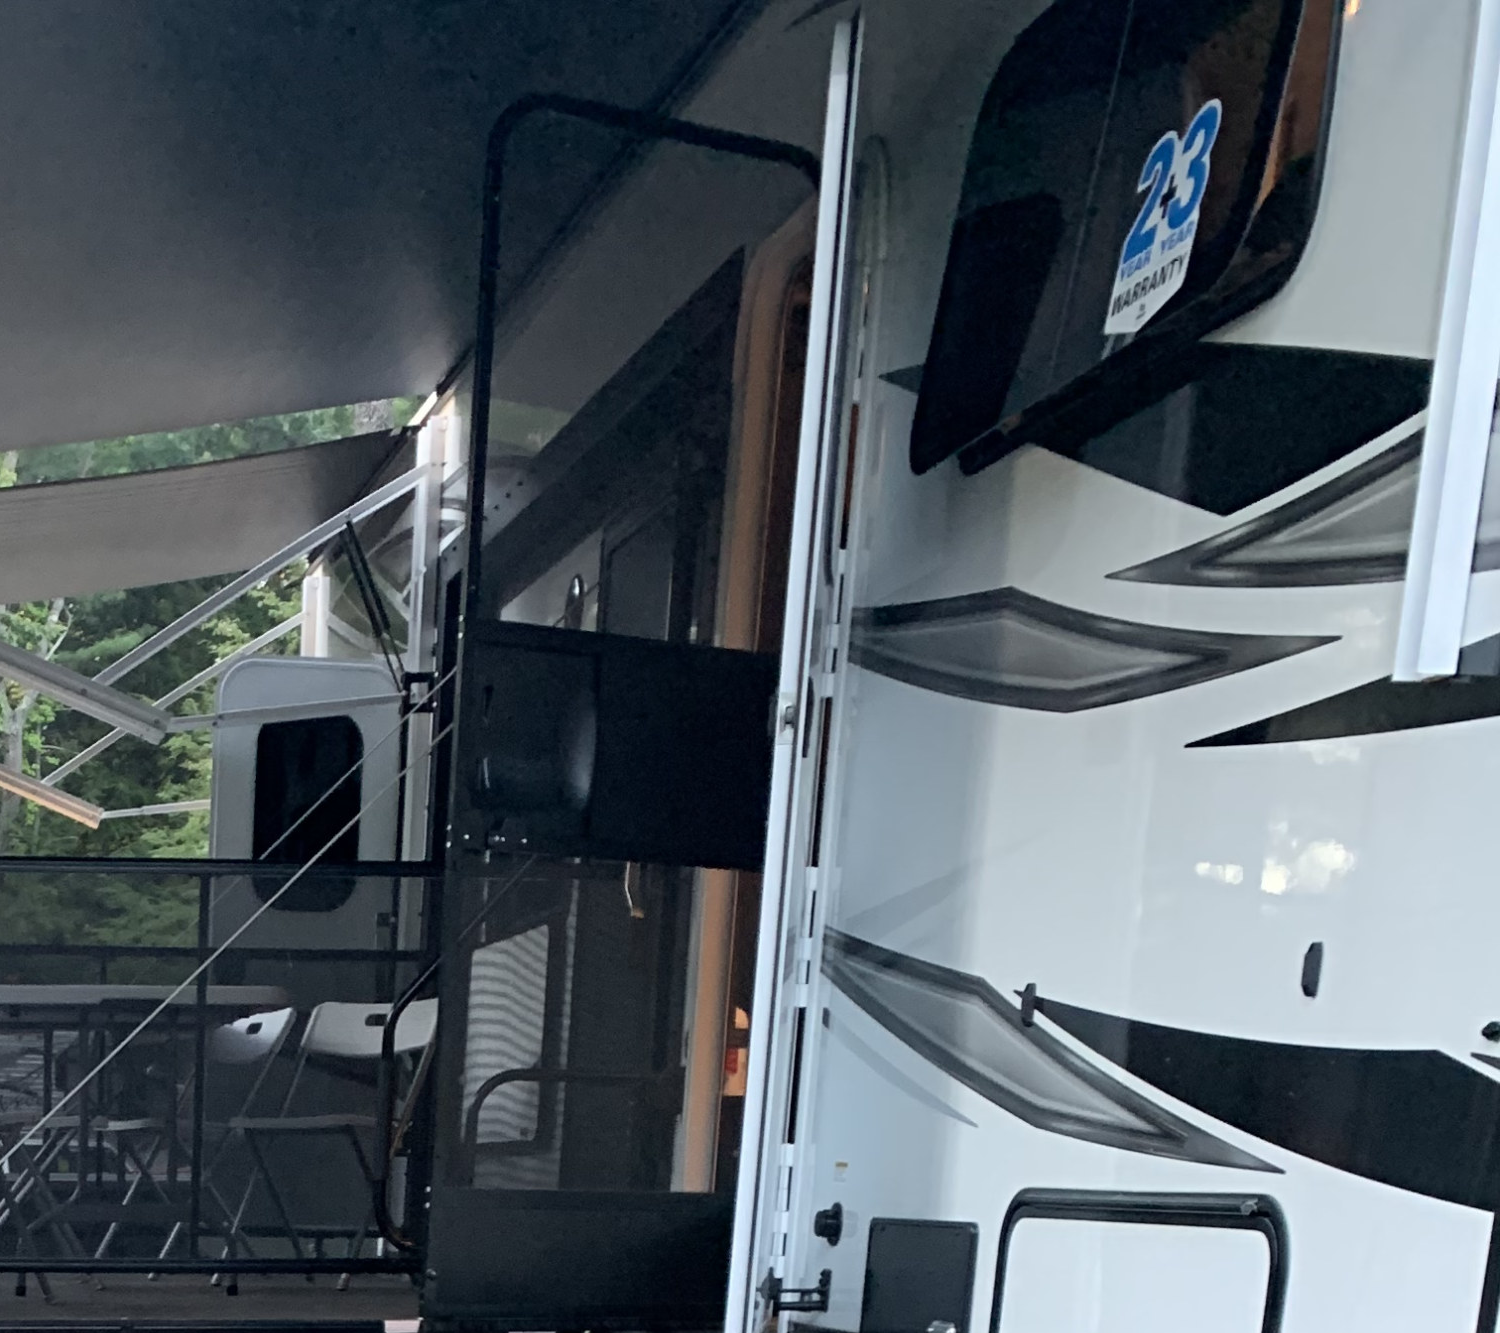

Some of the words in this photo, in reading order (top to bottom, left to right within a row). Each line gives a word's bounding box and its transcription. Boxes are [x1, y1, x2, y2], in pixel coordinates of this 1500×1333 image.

[1120, 247, 1152, 282] YEAR
[1160, 220, 1196, 255] YEAR
[1111, 252, 1188, 317] WARRANTY
